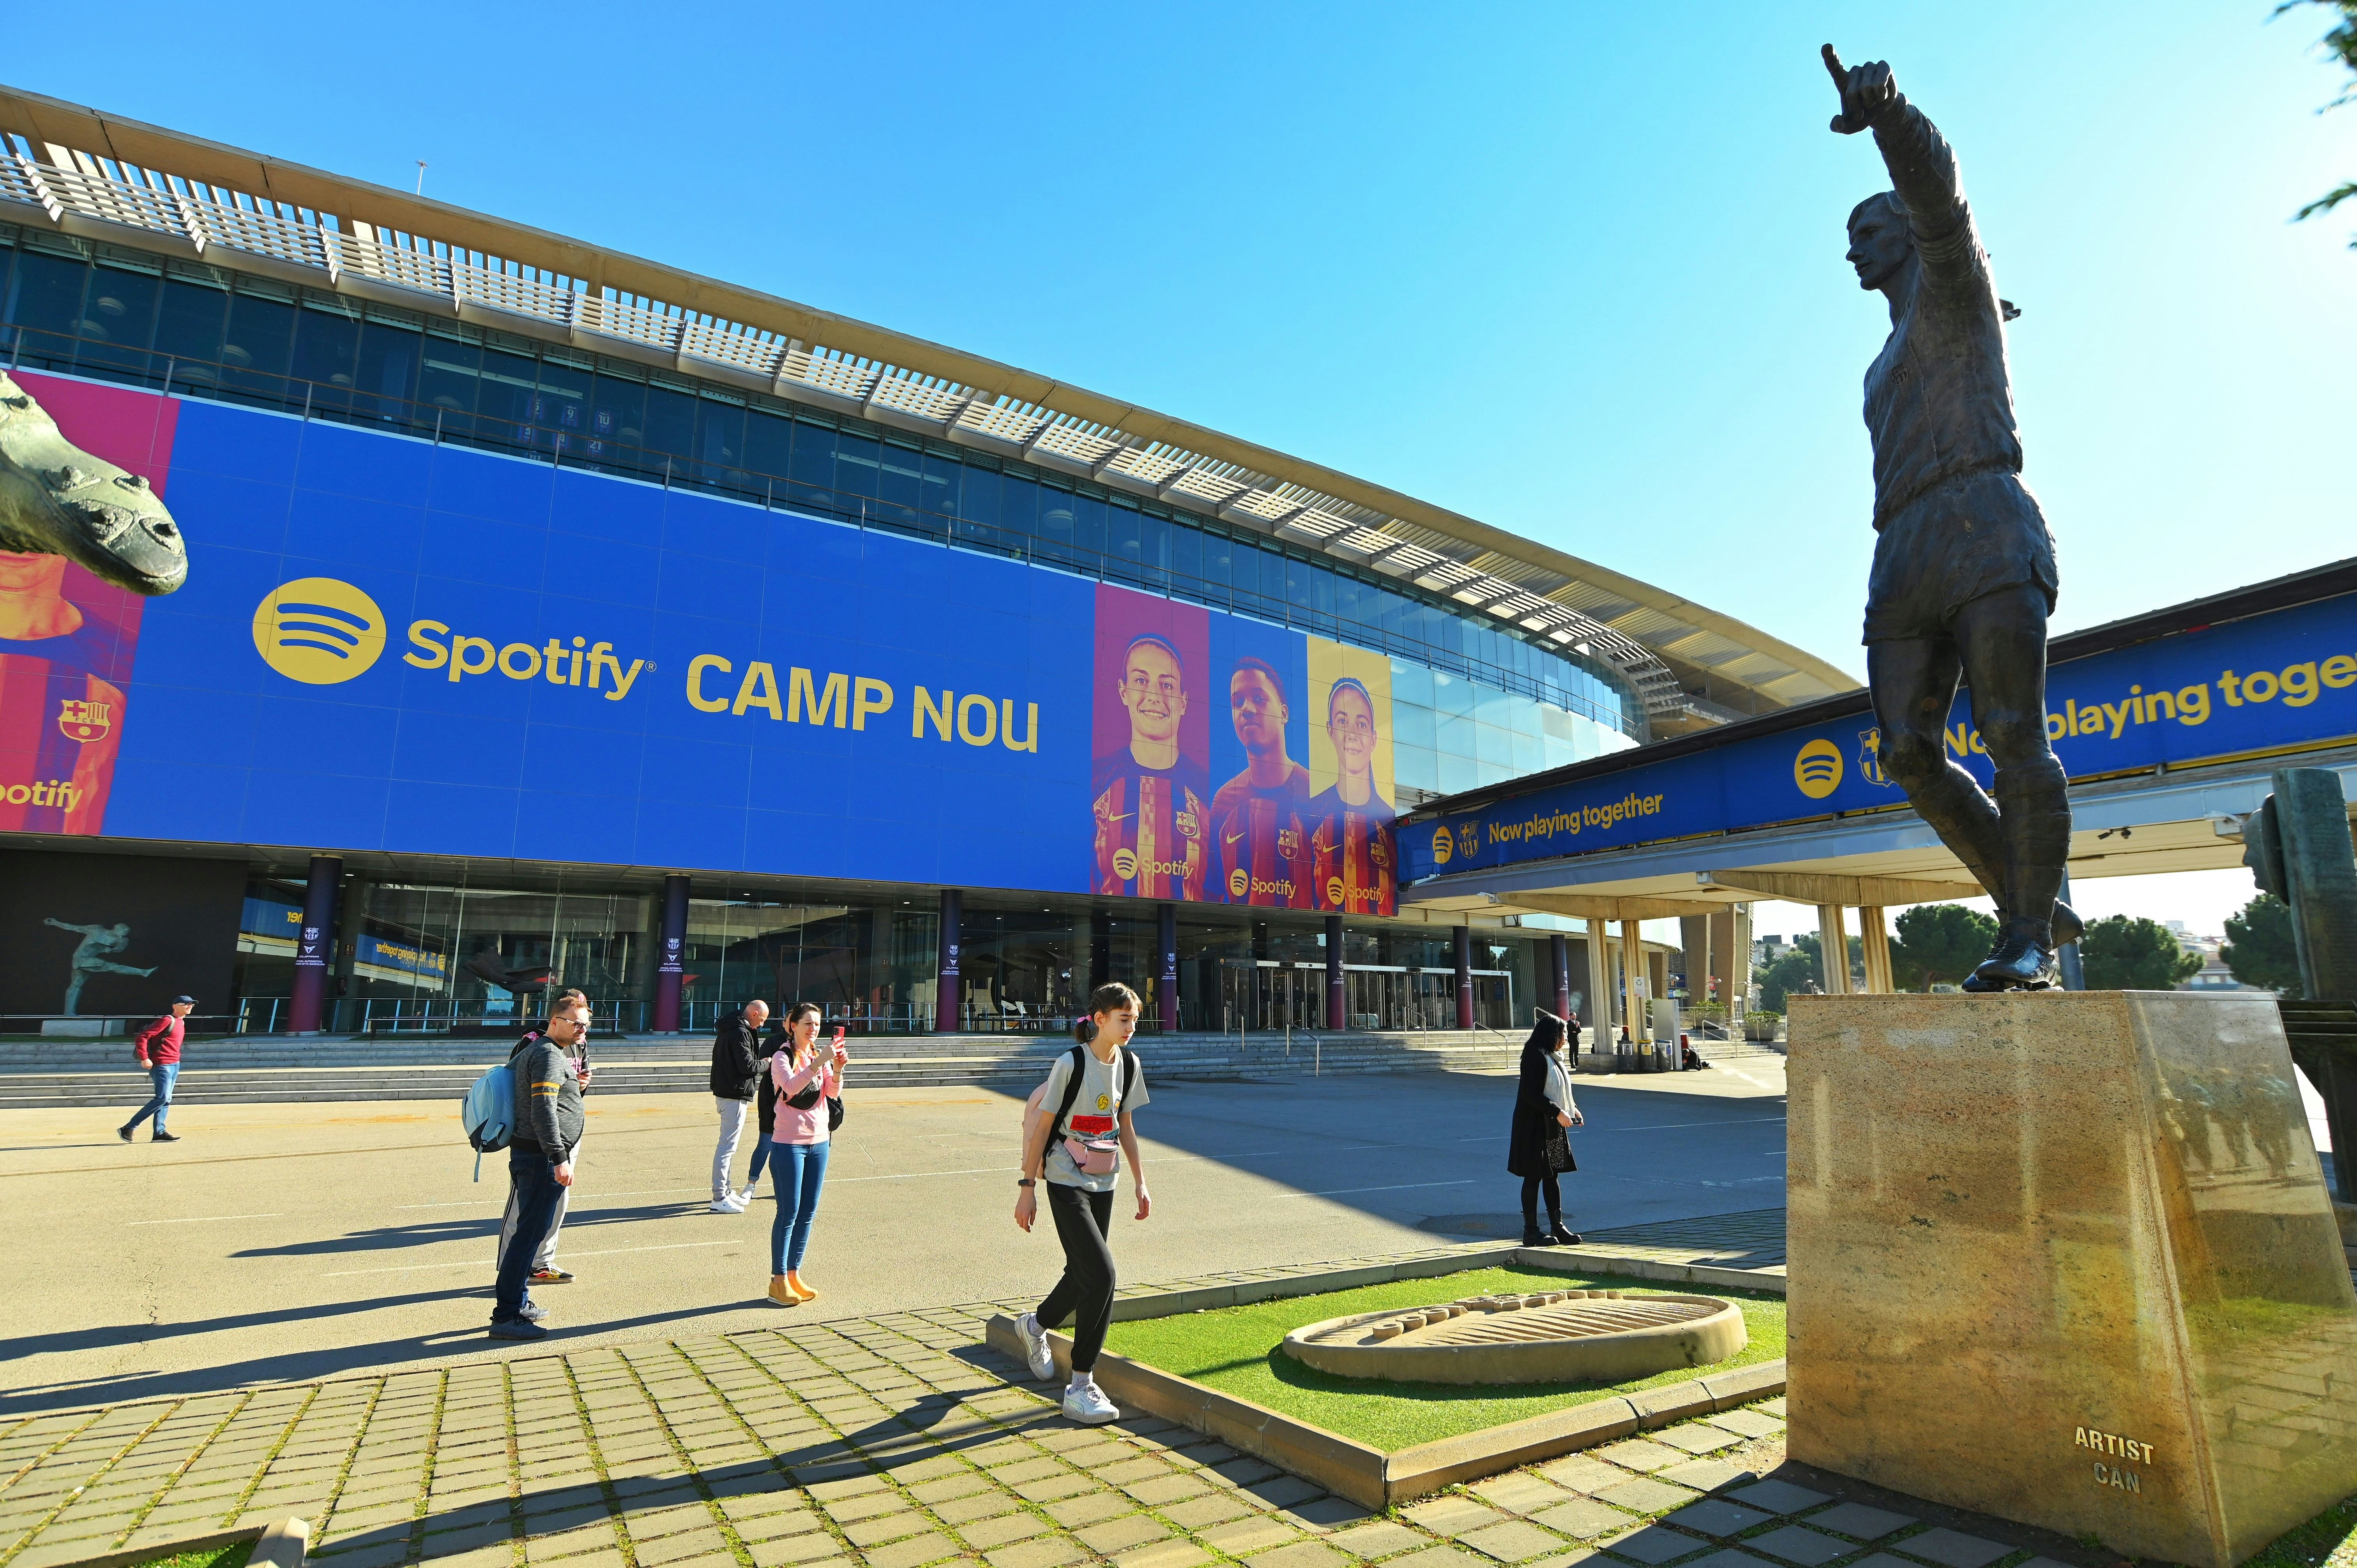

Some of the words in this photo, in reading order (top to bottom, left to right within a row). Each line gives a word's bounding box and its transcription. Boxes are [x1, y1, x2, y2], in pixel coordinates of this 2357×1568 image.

[567, 409, 574, 418] 9
[599, 415, 610, 425] 10
[590, 440, 602, 450] 21
[2217, 652, 2357, 707] toge
[686, 653, 894, 731] CAMP
[912, 685, 1038, 753] NOU
[1489, 822, 1522, 844] Now
[1525, 809, 1580, 842] playing
[1583, 793, 1667, 829] together
[1141, 857, 1194, 880] Spotify
[1251, 877, 1297, 899] Spotify
[1348, 884, 1385, 904] Spotify
[1072, 1117, 1111, 1132] BARÇA
[2075, 1426, 2154, 1464] ARTIST
[2094, 1462, 2140, 1494] CAN
